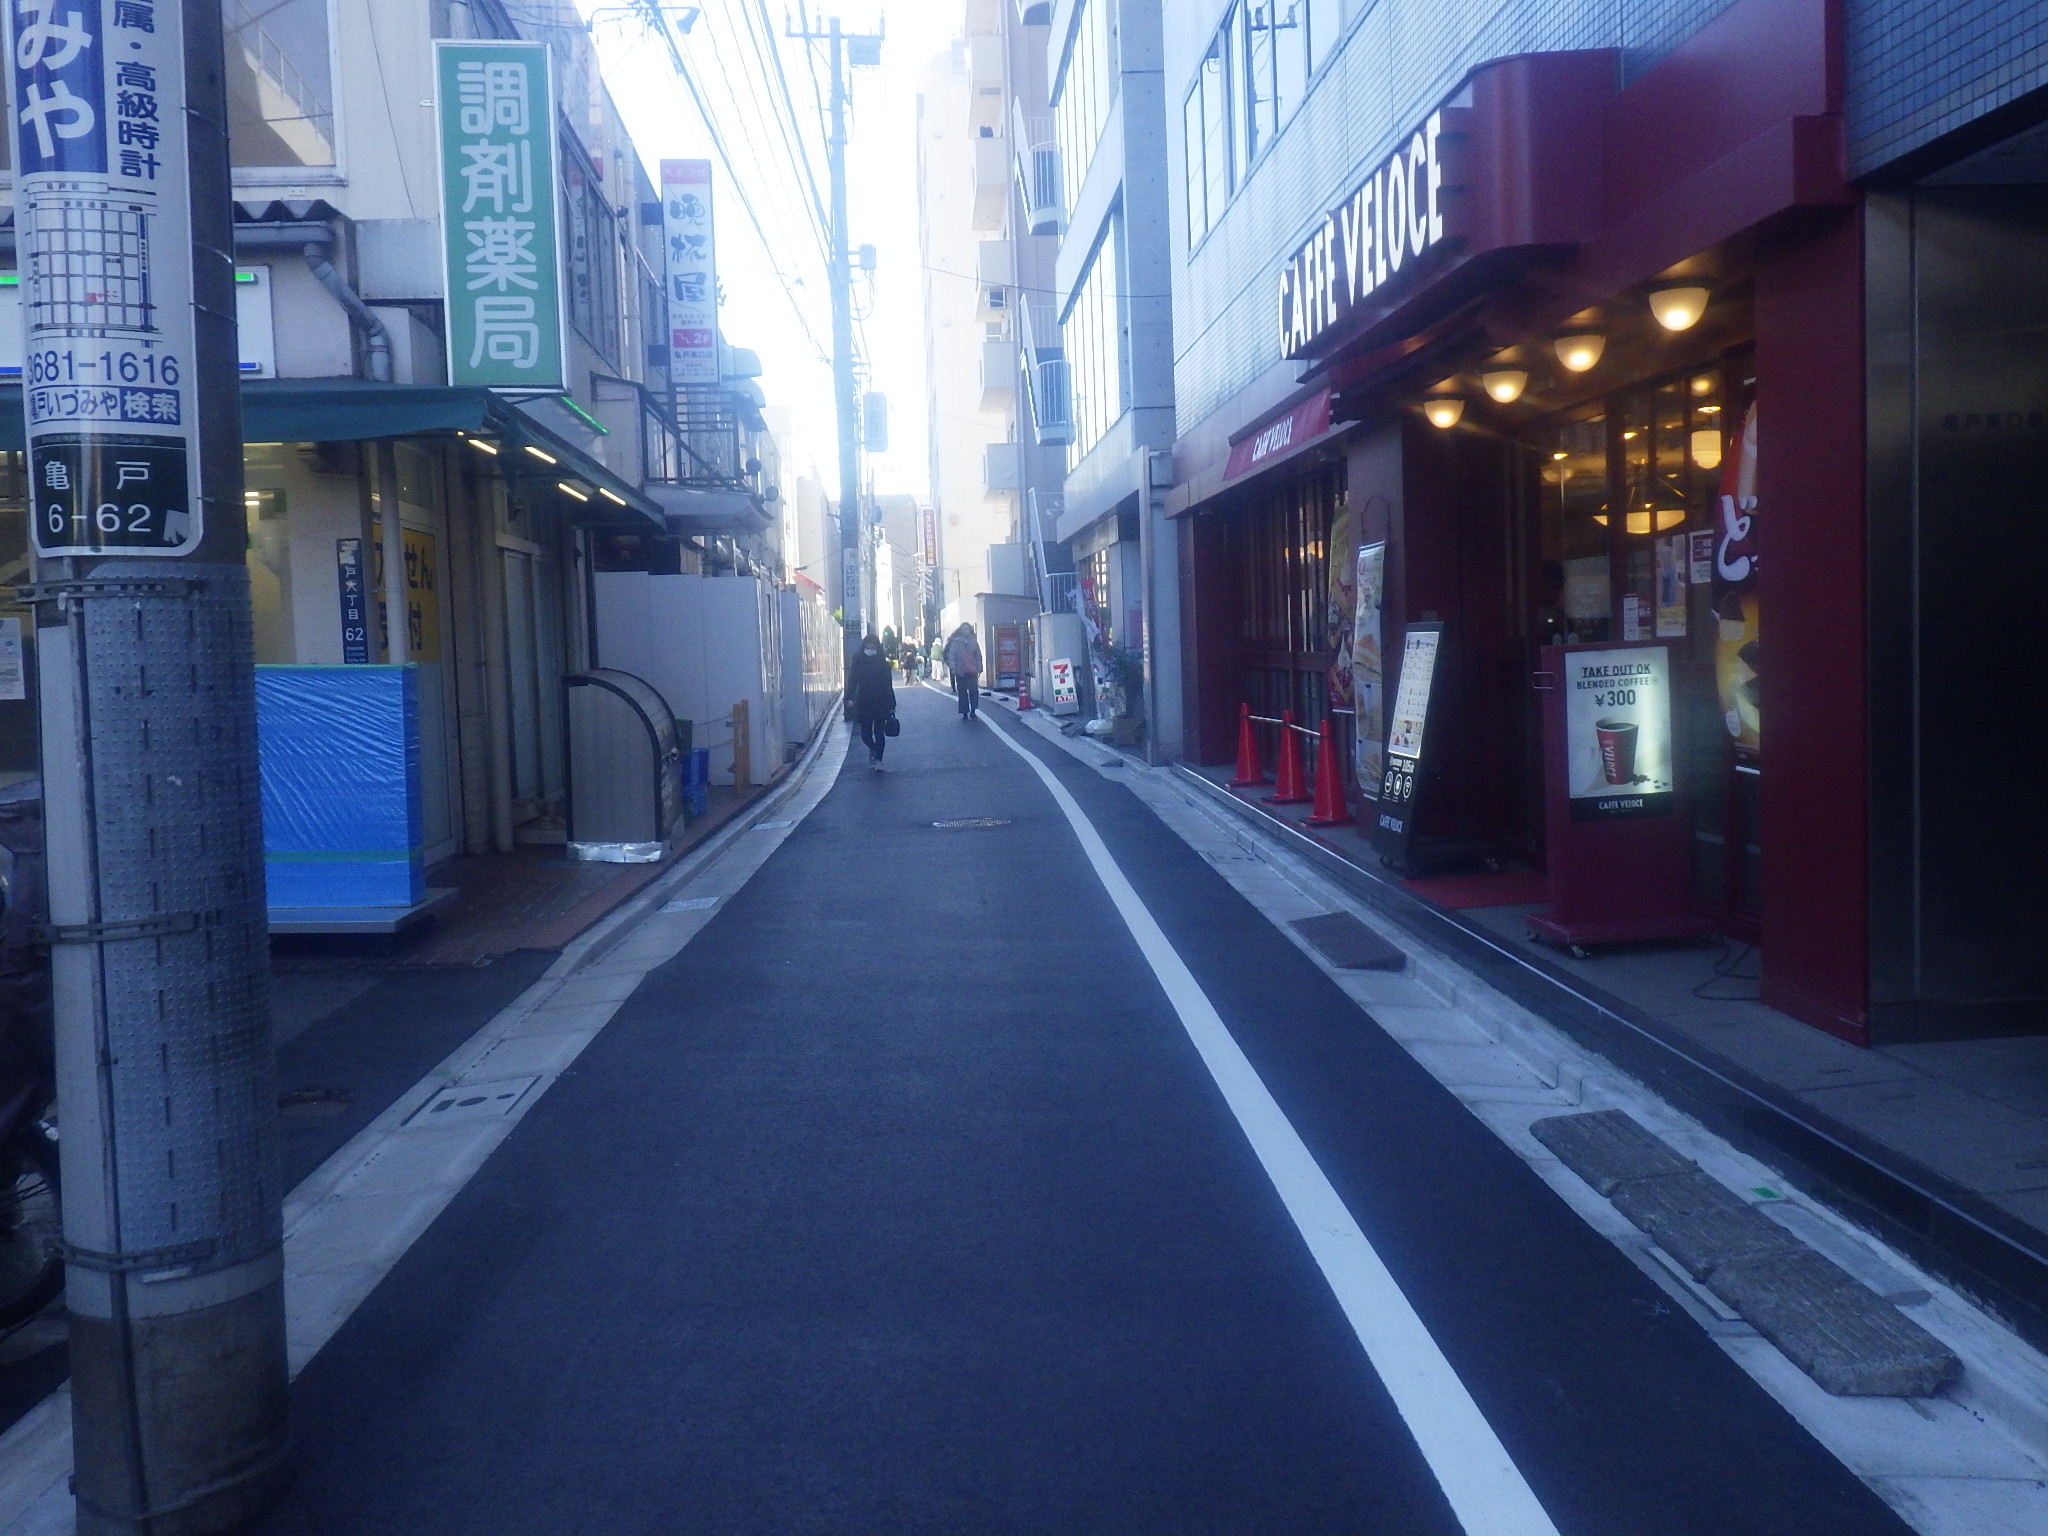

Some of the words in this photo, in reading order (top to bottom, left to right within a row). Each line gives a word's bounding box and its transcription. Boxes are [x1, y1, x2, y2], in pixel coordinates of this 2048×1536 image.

[457, 61, 539, 369] 調剤薬局
[1341, 110, 1442, 307] VELOCE
[123, 391, 176, 421] 検索
[44, 460, 151, 490] 亀戸
[48, 503, 151, 533] 6-62
[345, 628, 363, 641] 62
[1582, 666, 1609, 678] TAKE
[1612, 664, 1633, 676] OUT
[1636, 663, 1651, 675] OK
[1576, 679, 1615, 690] BLENDED
[1617, 677, 1649, 687] COFFEE
[1595, 690, 1636, 707] ¥300
[1620, 798, 1643, 809] VELOCE
